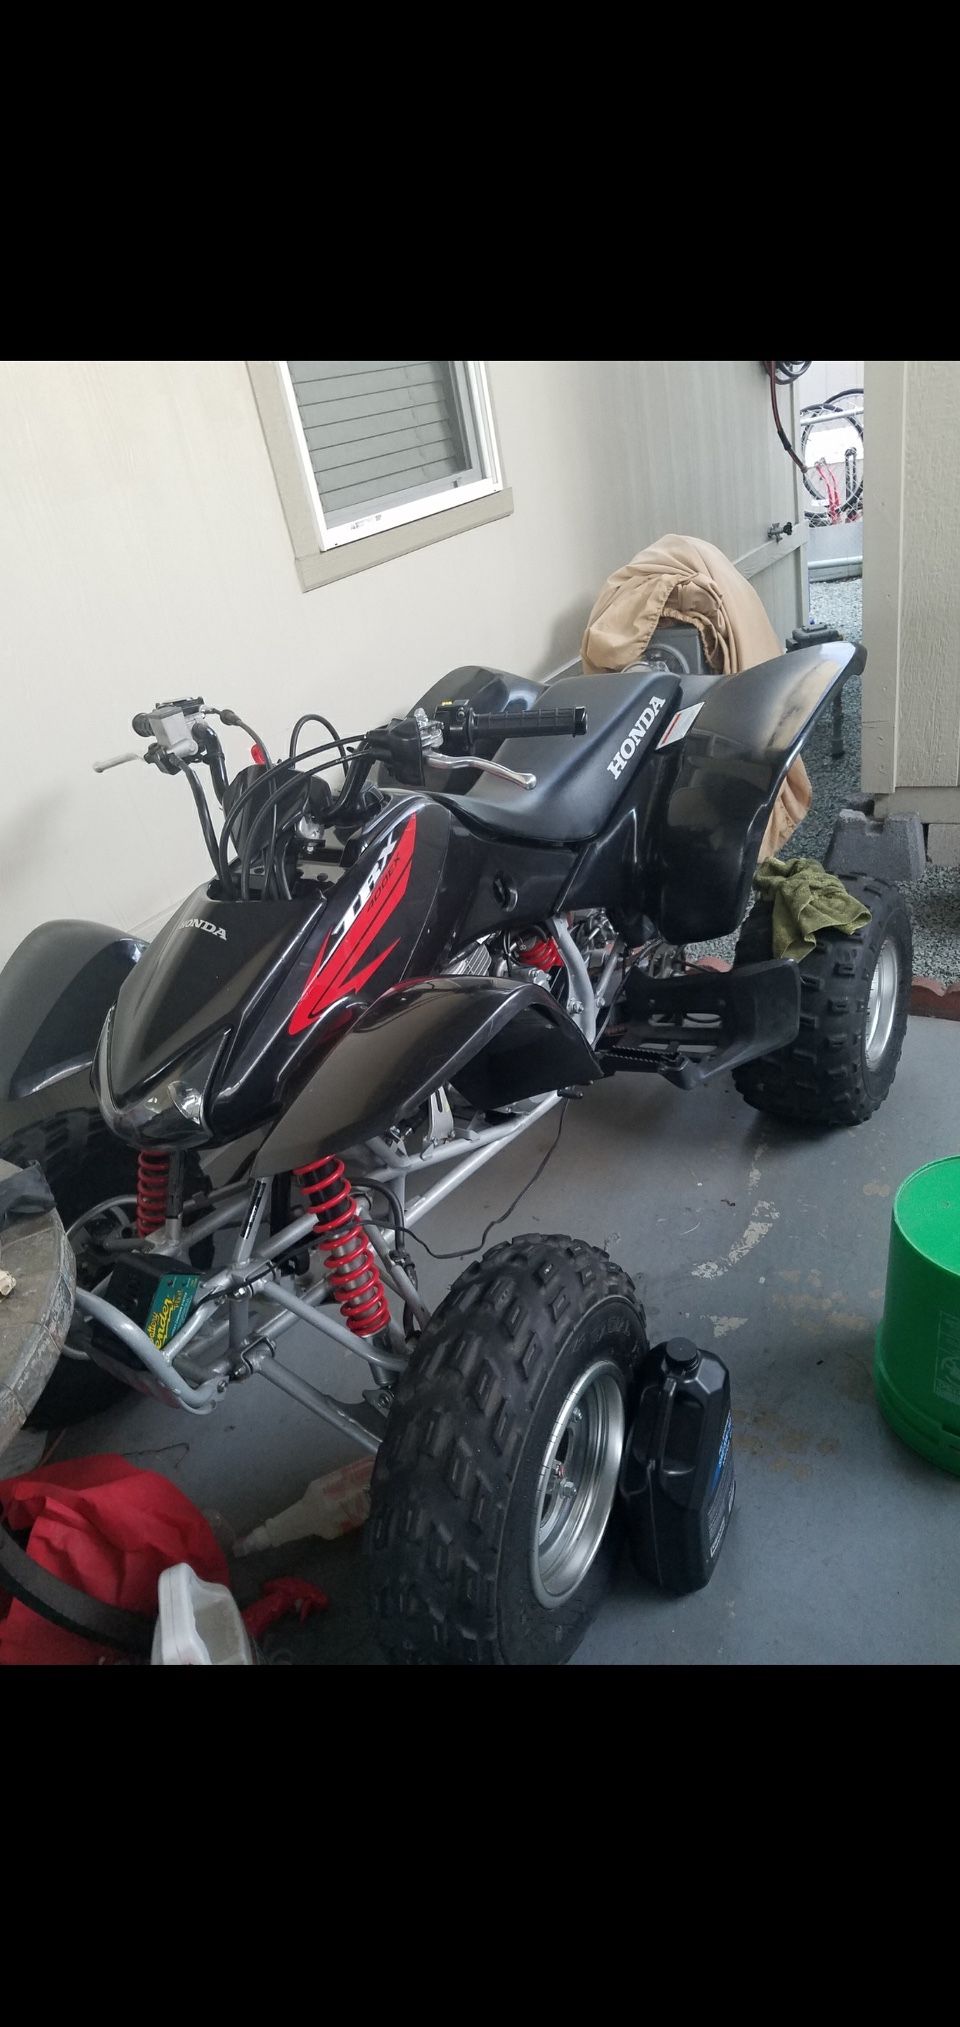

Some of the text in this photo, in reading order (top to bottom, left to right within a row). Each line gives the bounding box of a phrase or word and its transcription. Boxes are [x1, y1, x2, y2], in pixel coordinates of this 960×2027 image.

[606, 696, 666, 780] HONDA
[331, 831, 398, 935] TRX
[367, 853, 401, 913] 400EX
[147, 1311, 159, 1343] attery
[155, 1297, 173, 1350] ender
